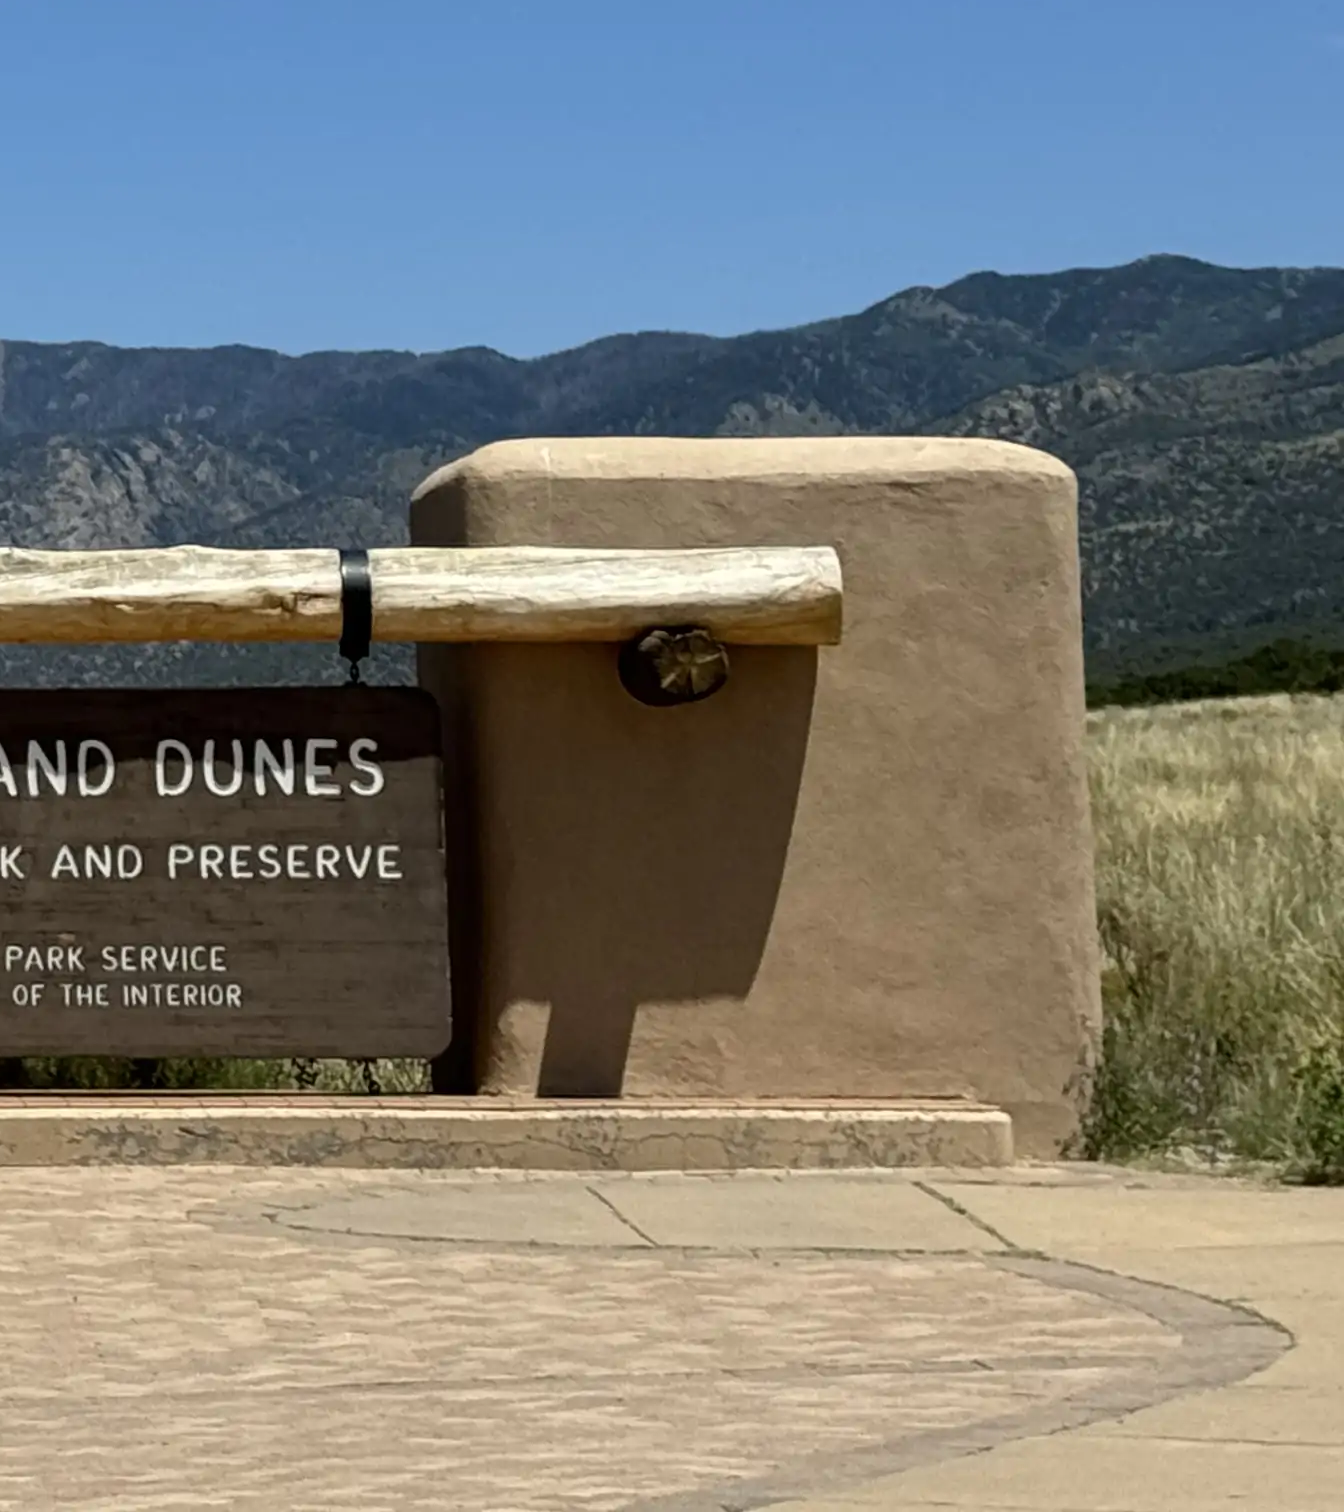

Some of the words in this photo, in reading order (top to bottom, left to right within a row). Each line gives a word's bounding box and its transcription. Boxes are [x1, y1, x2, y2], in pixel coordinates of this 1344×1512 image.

[154, 738, 387, 798] DUNES
[50, 844, 145, 880] AND
[167, 844, 405, 881] PRESERVE
[5, 945, 86, 973] PARK
[102, 945, 229, 973] SERVICE
[12, 983, 47, 1009] OF
[62, 983, 110, 1009] THE
[123, 983, 244, 1009] INTERIOR
